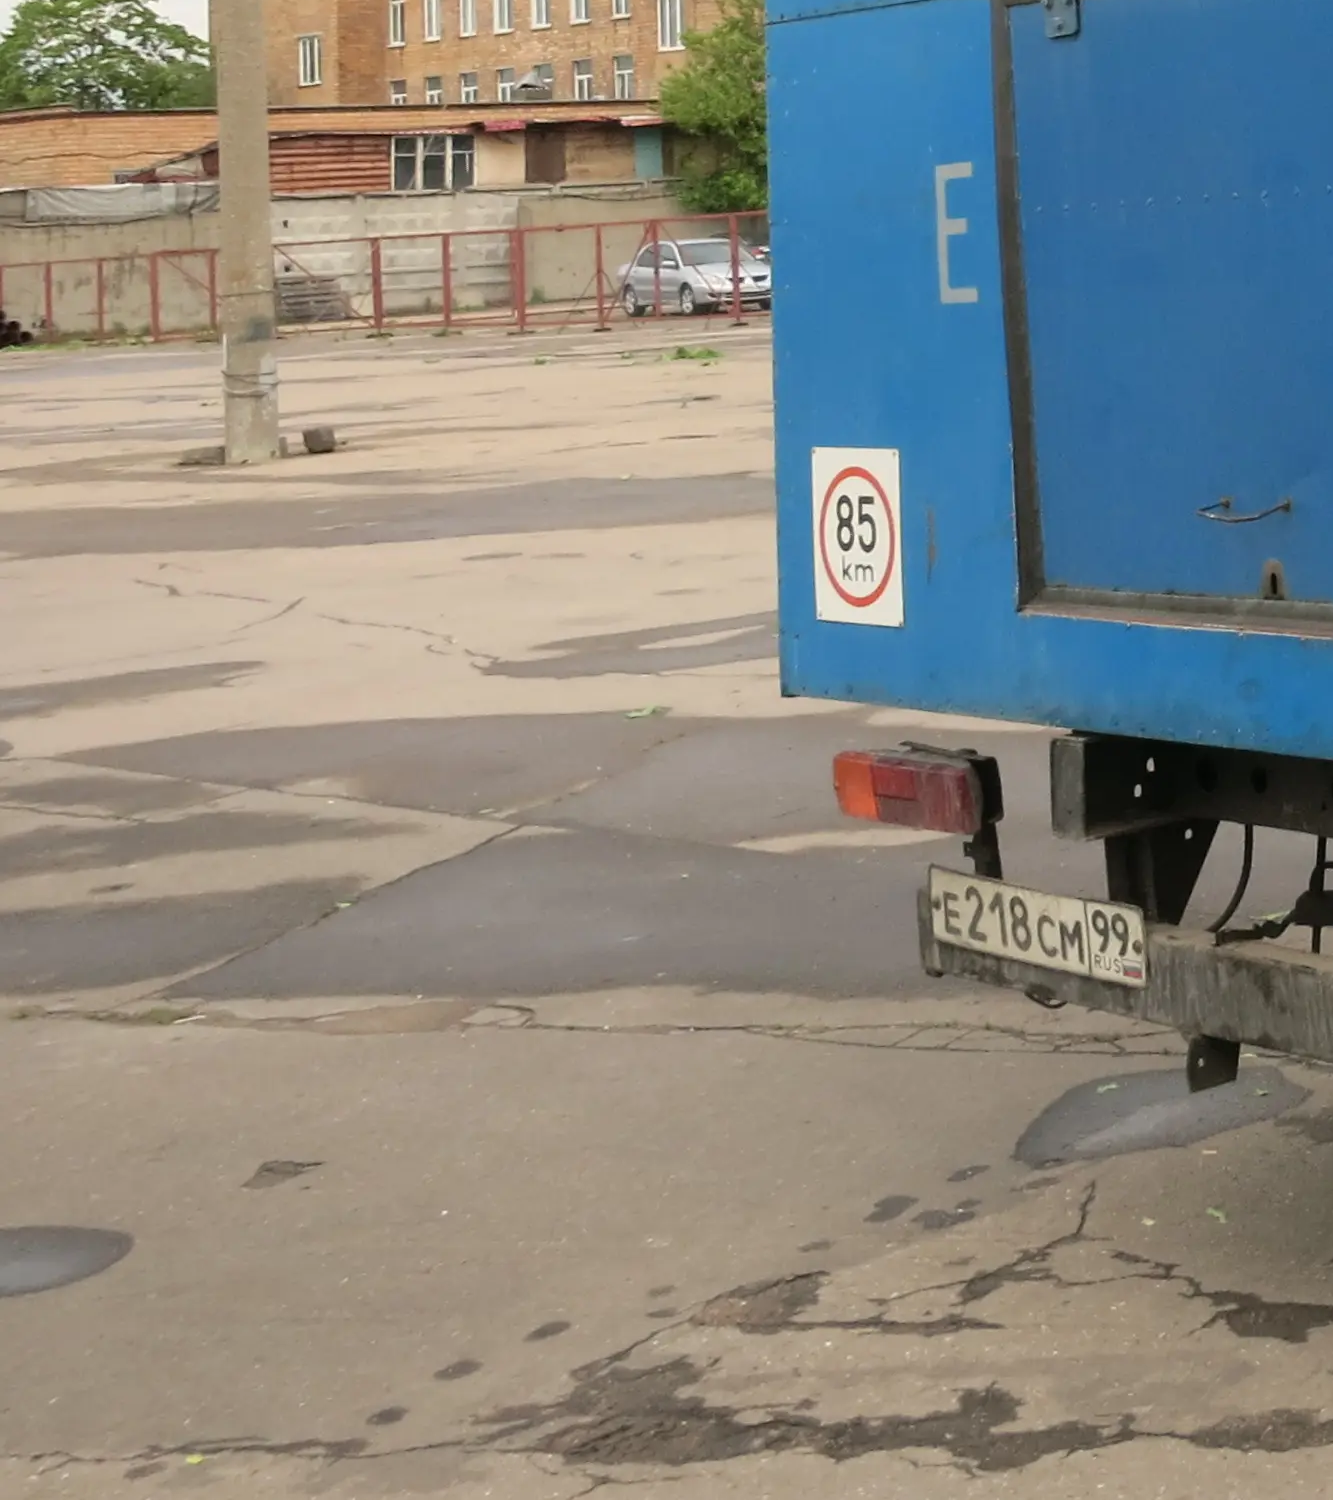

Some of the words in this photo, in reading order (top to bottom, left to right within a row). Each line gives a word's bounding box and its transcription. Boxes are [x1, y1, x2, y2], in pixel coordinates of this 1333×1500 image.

[836, 494, 877, 554] 85
[841, 555, 875, 582] km
[1091, 909, 1129, 958] 99
[1094, 953, 1122, 975] RUS
